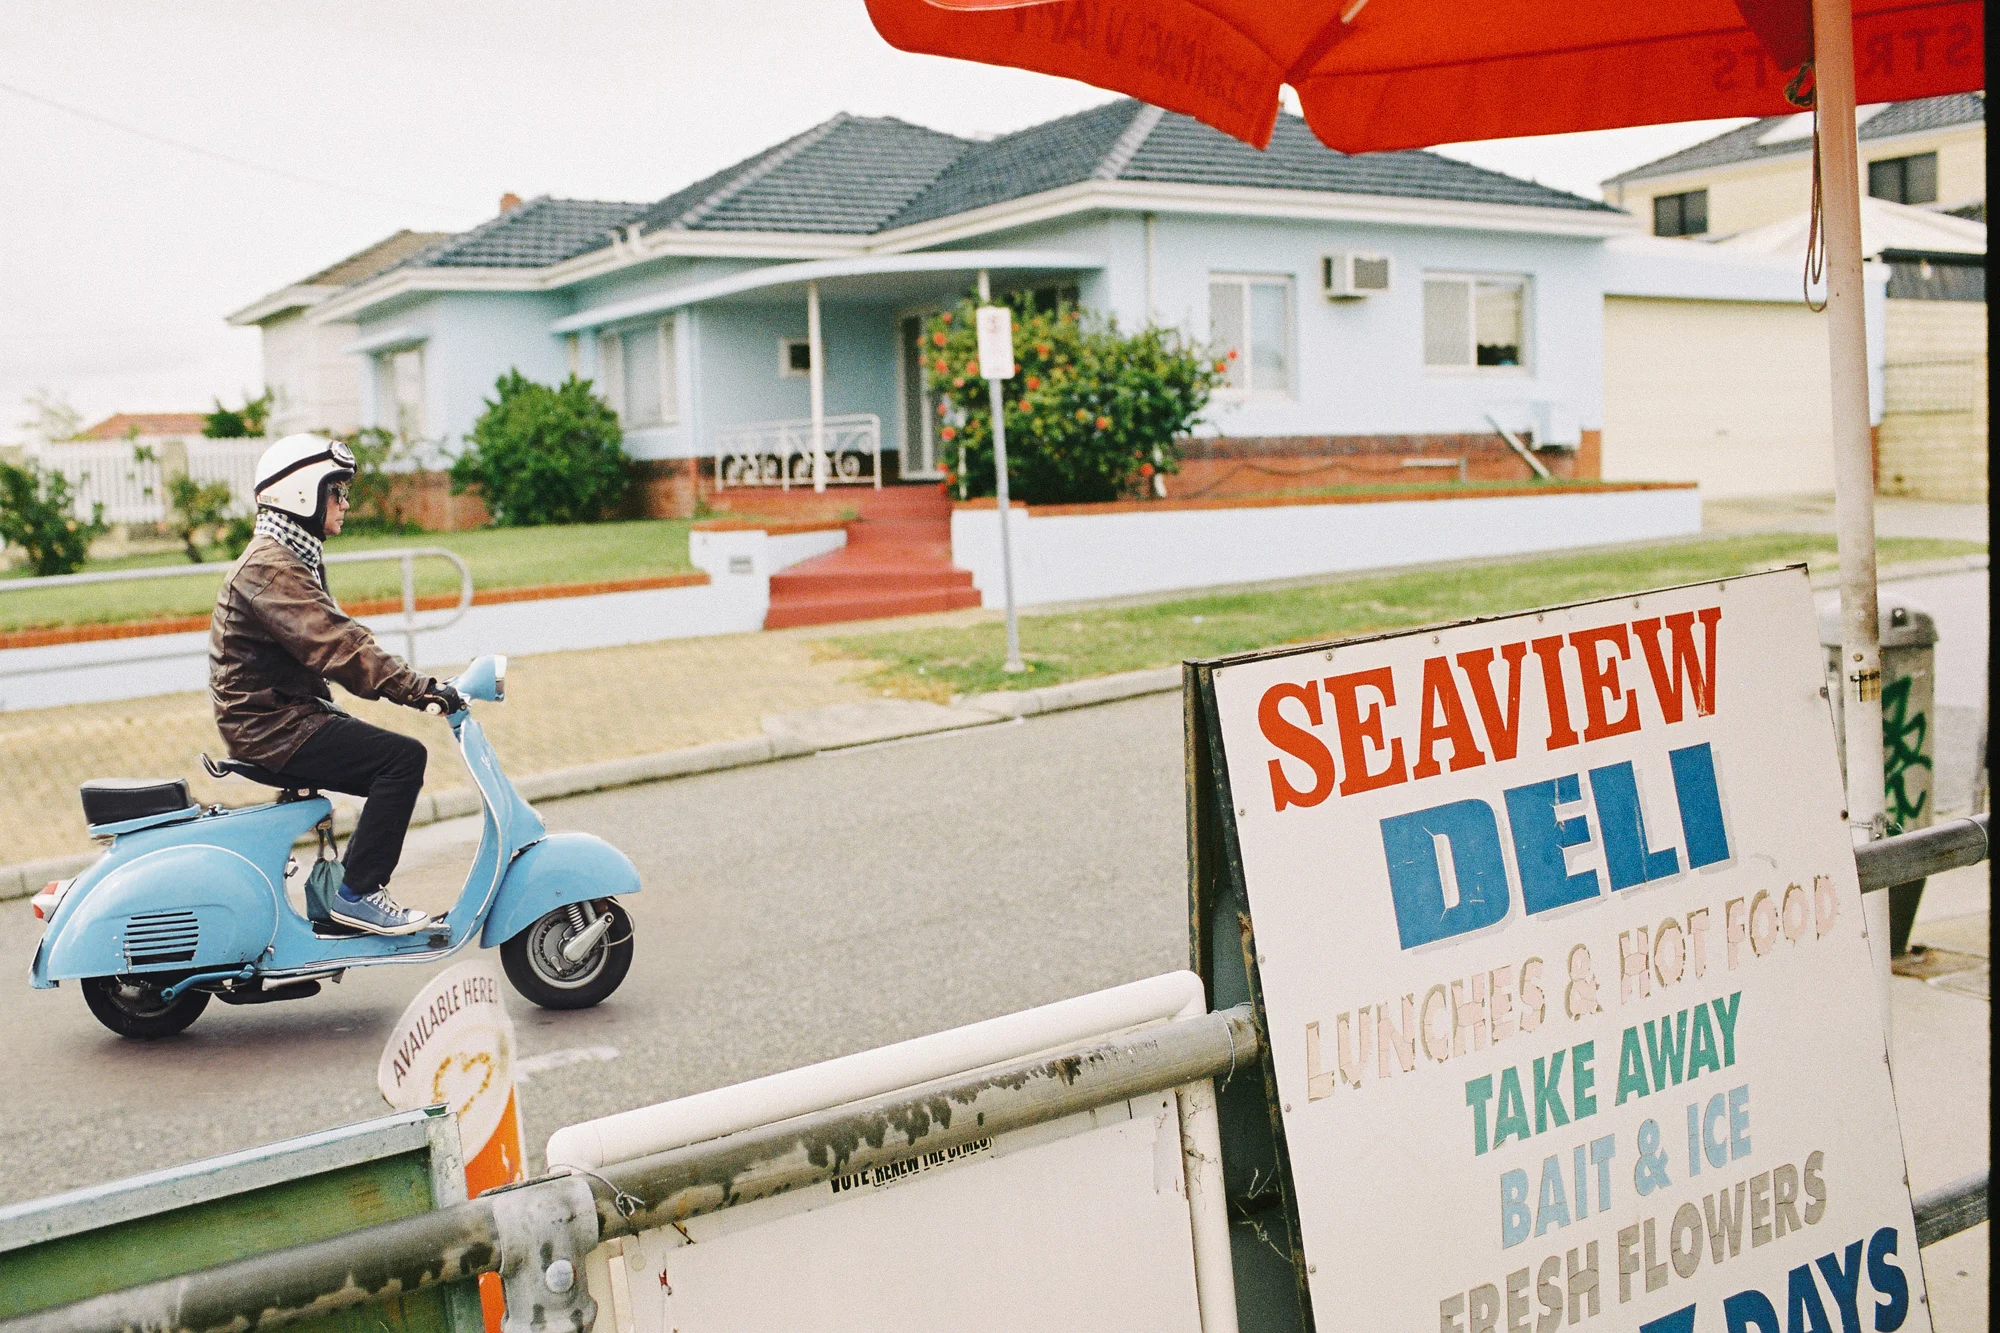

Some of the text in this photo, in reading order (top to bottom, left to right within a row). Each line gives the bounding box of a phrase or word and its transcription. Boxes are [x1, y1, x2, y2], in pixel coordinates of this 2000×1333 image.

[1258, 607, 1722, 812] SEAVIEW
[1380, 742, 1733, 952] DELI
[393, 977, 498, 1088] AVAILABLE HERE!
[1306, 874, 1840, 1104] LUNCHES & HOT FOOD
[1465, 990, 1742, 1157] TAKE AWAY
[831, 1170, 870, 1194] VOTE
[1440, 1150, 1827, 1333] FRESH FLOWERS
[1500, 1083, 1752, 1250] BAIT & ICE
